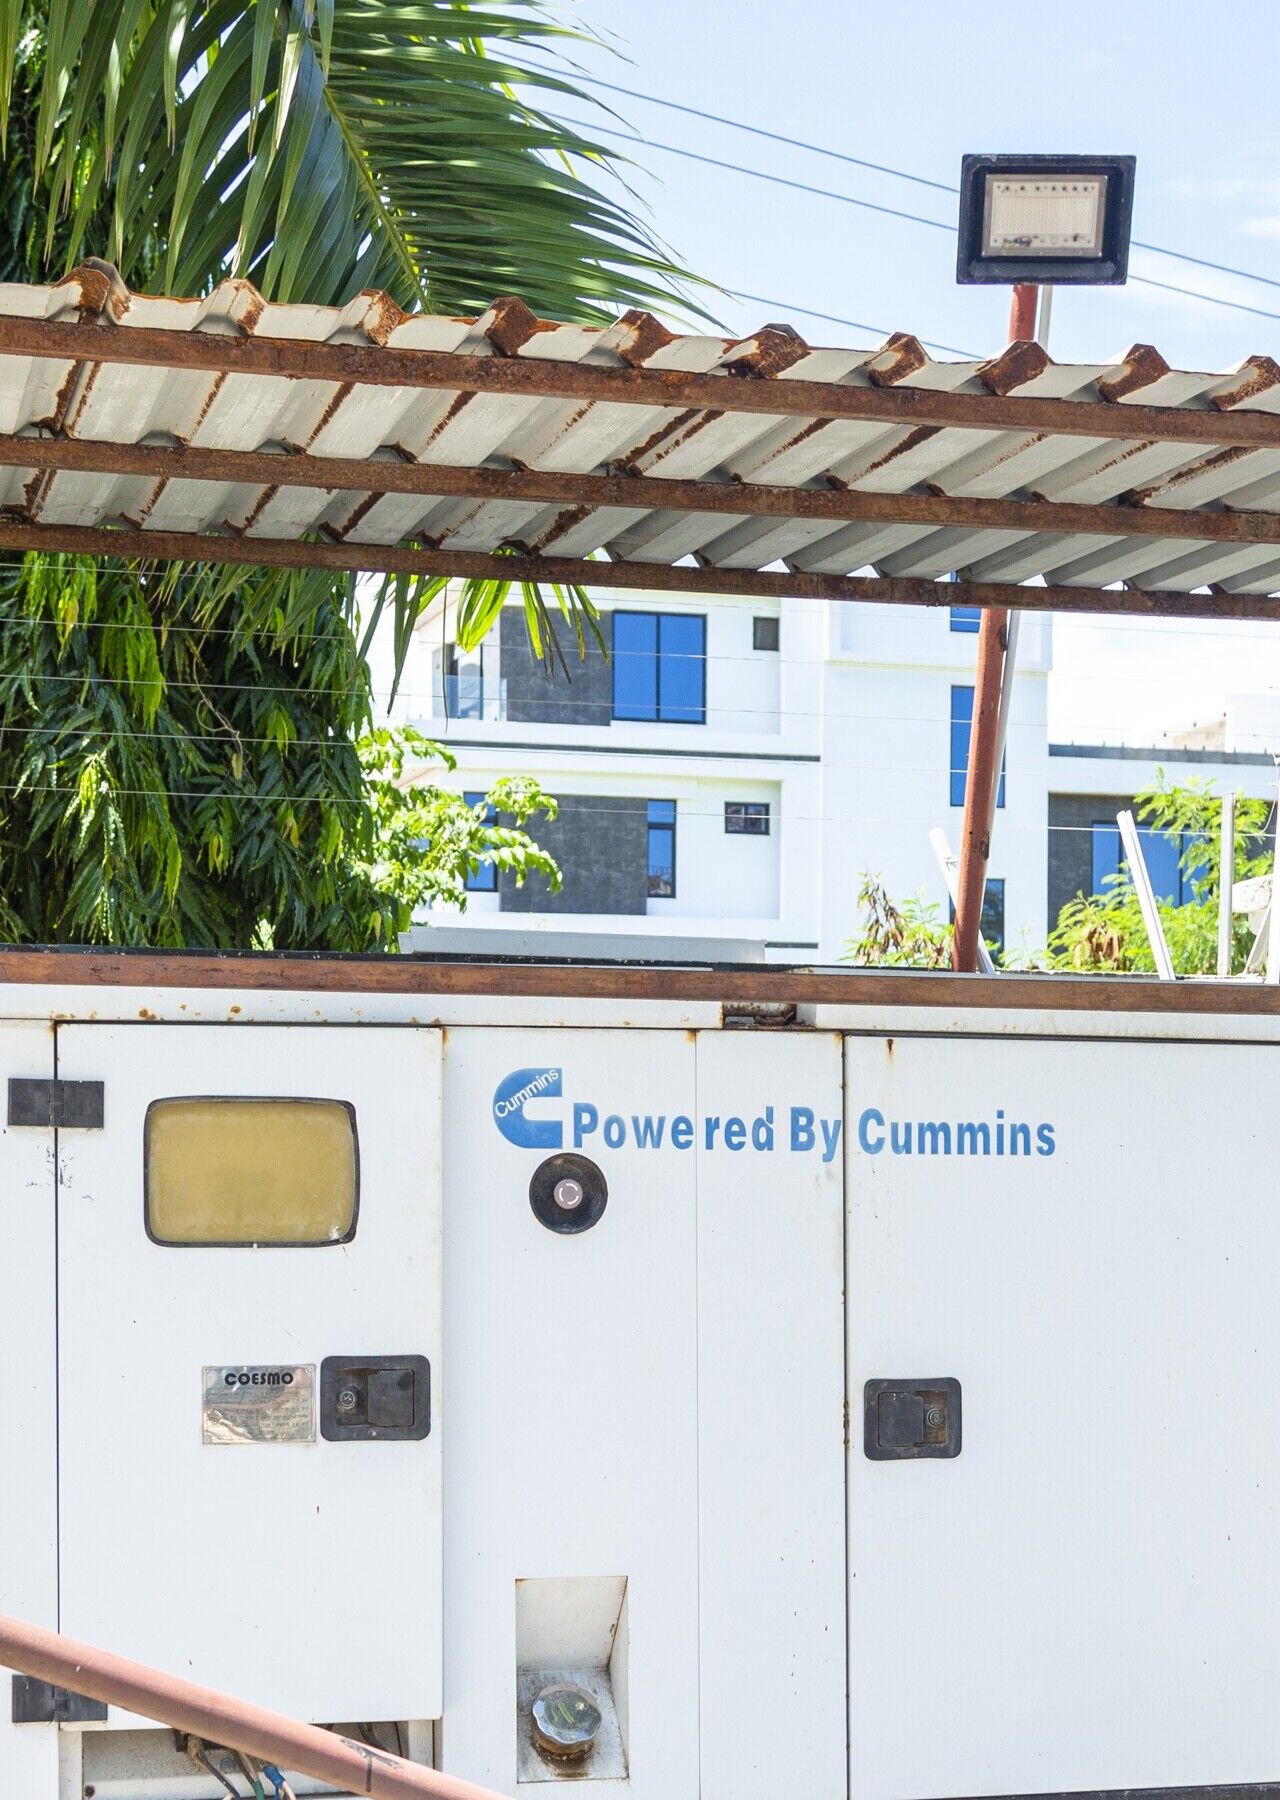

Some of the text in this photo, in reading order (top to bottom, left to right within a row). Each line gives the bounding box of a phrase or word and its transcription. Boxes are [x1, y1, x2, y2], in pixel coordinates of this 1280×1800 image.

[494, 1068, 559, 1118] Cummins
[573, 1102, 1057, 1163] Powered By Cummins
[225, 1372, 294, 1386] COESMO
